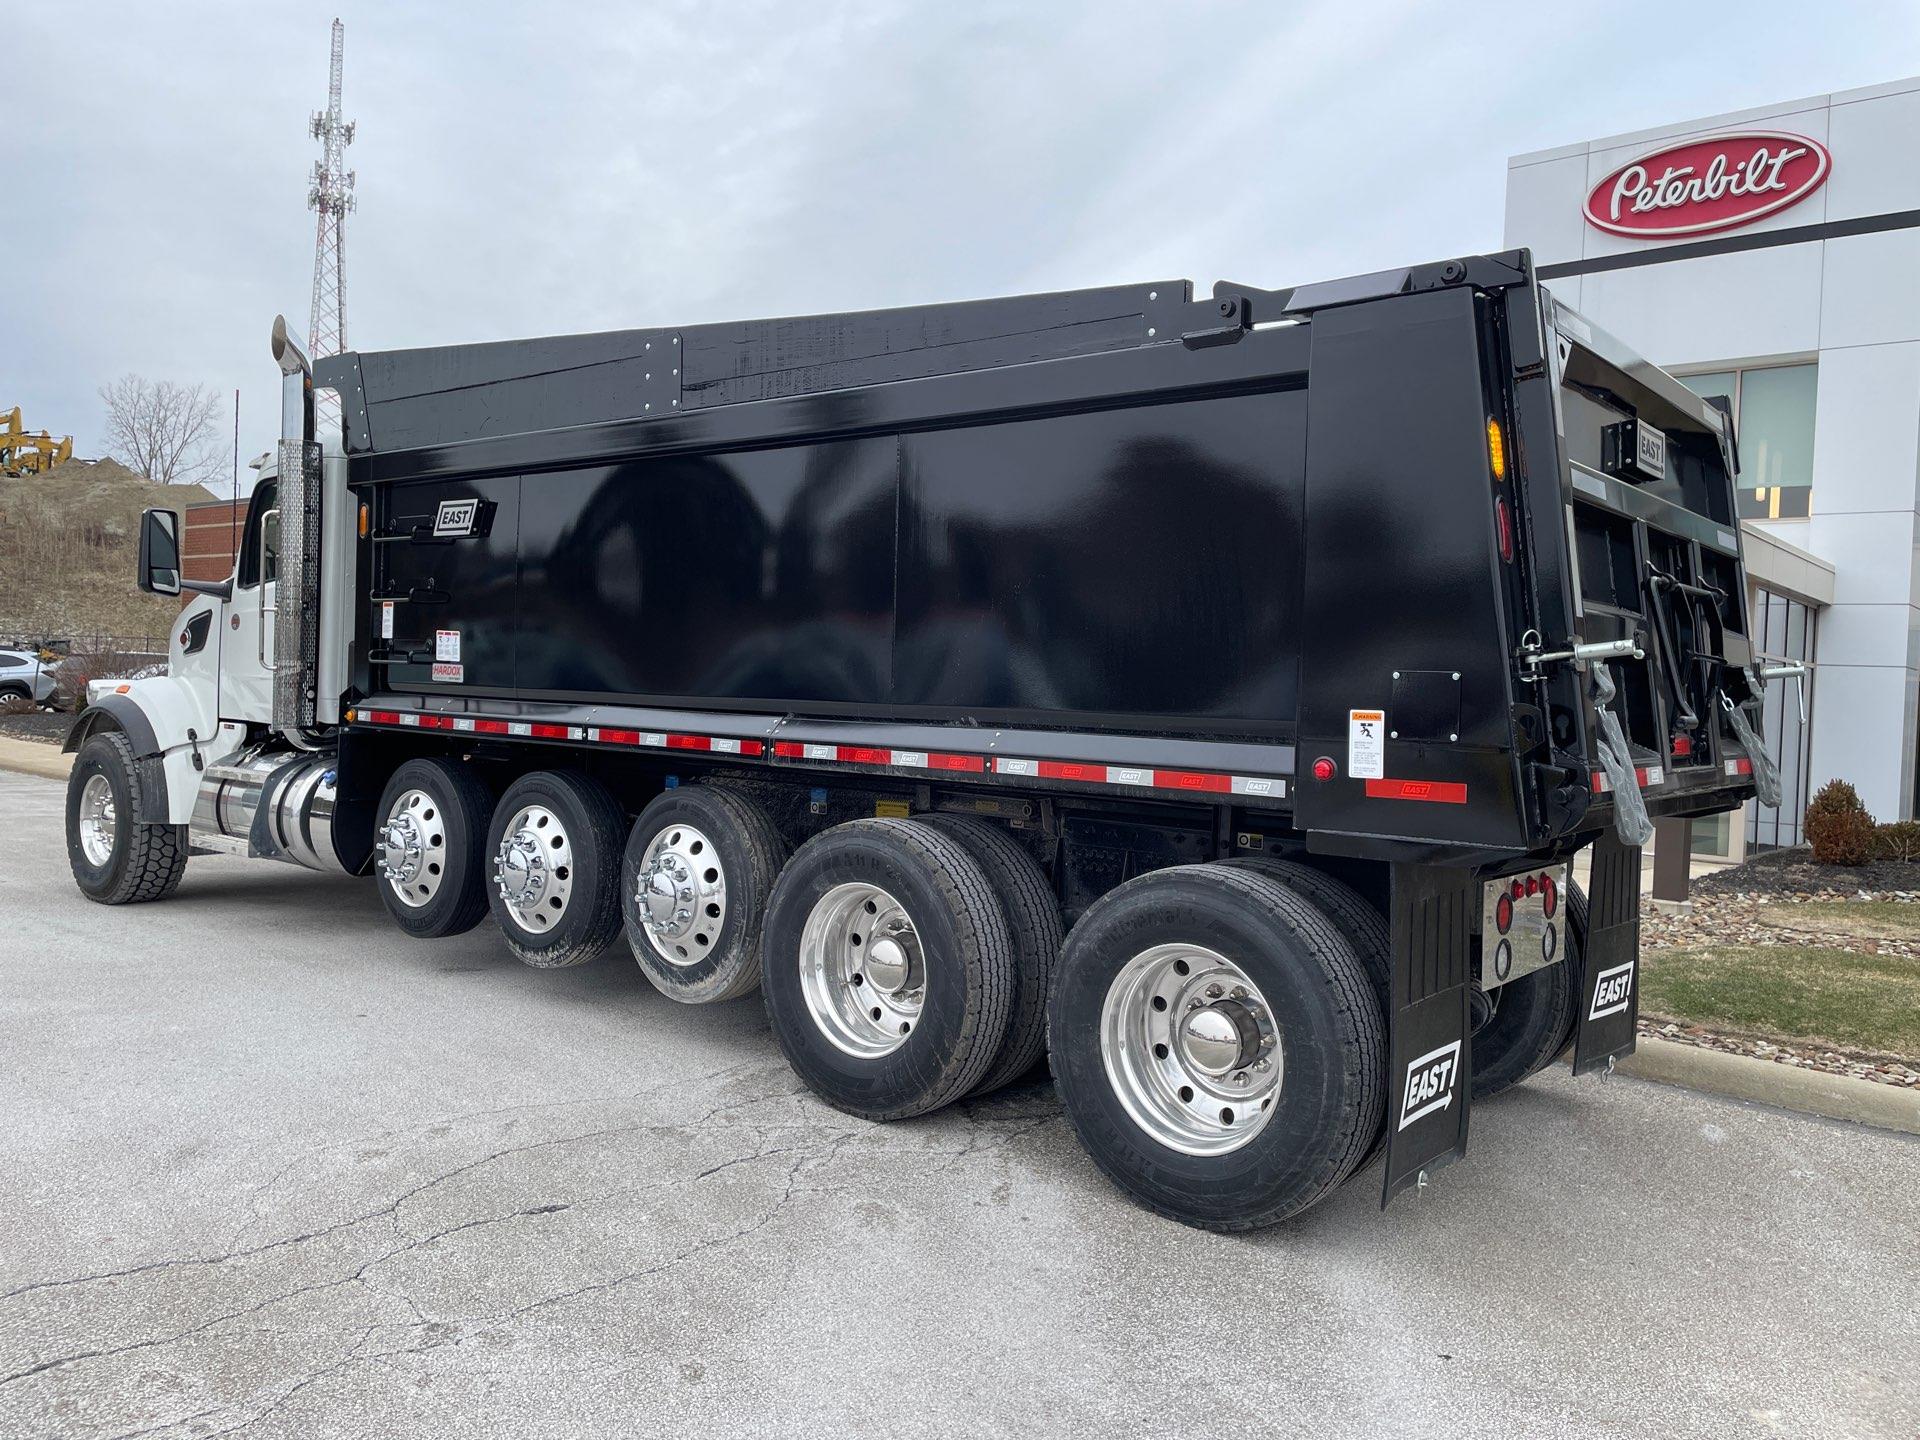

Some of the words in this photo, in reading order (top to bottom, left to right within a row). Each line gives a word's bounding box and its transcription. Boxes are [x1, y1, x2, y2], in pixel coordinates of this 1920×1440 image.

[1610, 147, 1807, 221] Peterbilt
[1641, 435, 1661, 462] EAST
[441, 510, 469, 525] EAST
[434, 665, 461, 676] HARDOX
[1248, 782, 1268, 792] EAST
[1405, 786, 1426, 794] EAST
[1596, 974, 1629, 1007] EAST
[1406, 1059, 1452, 1110] EAST
